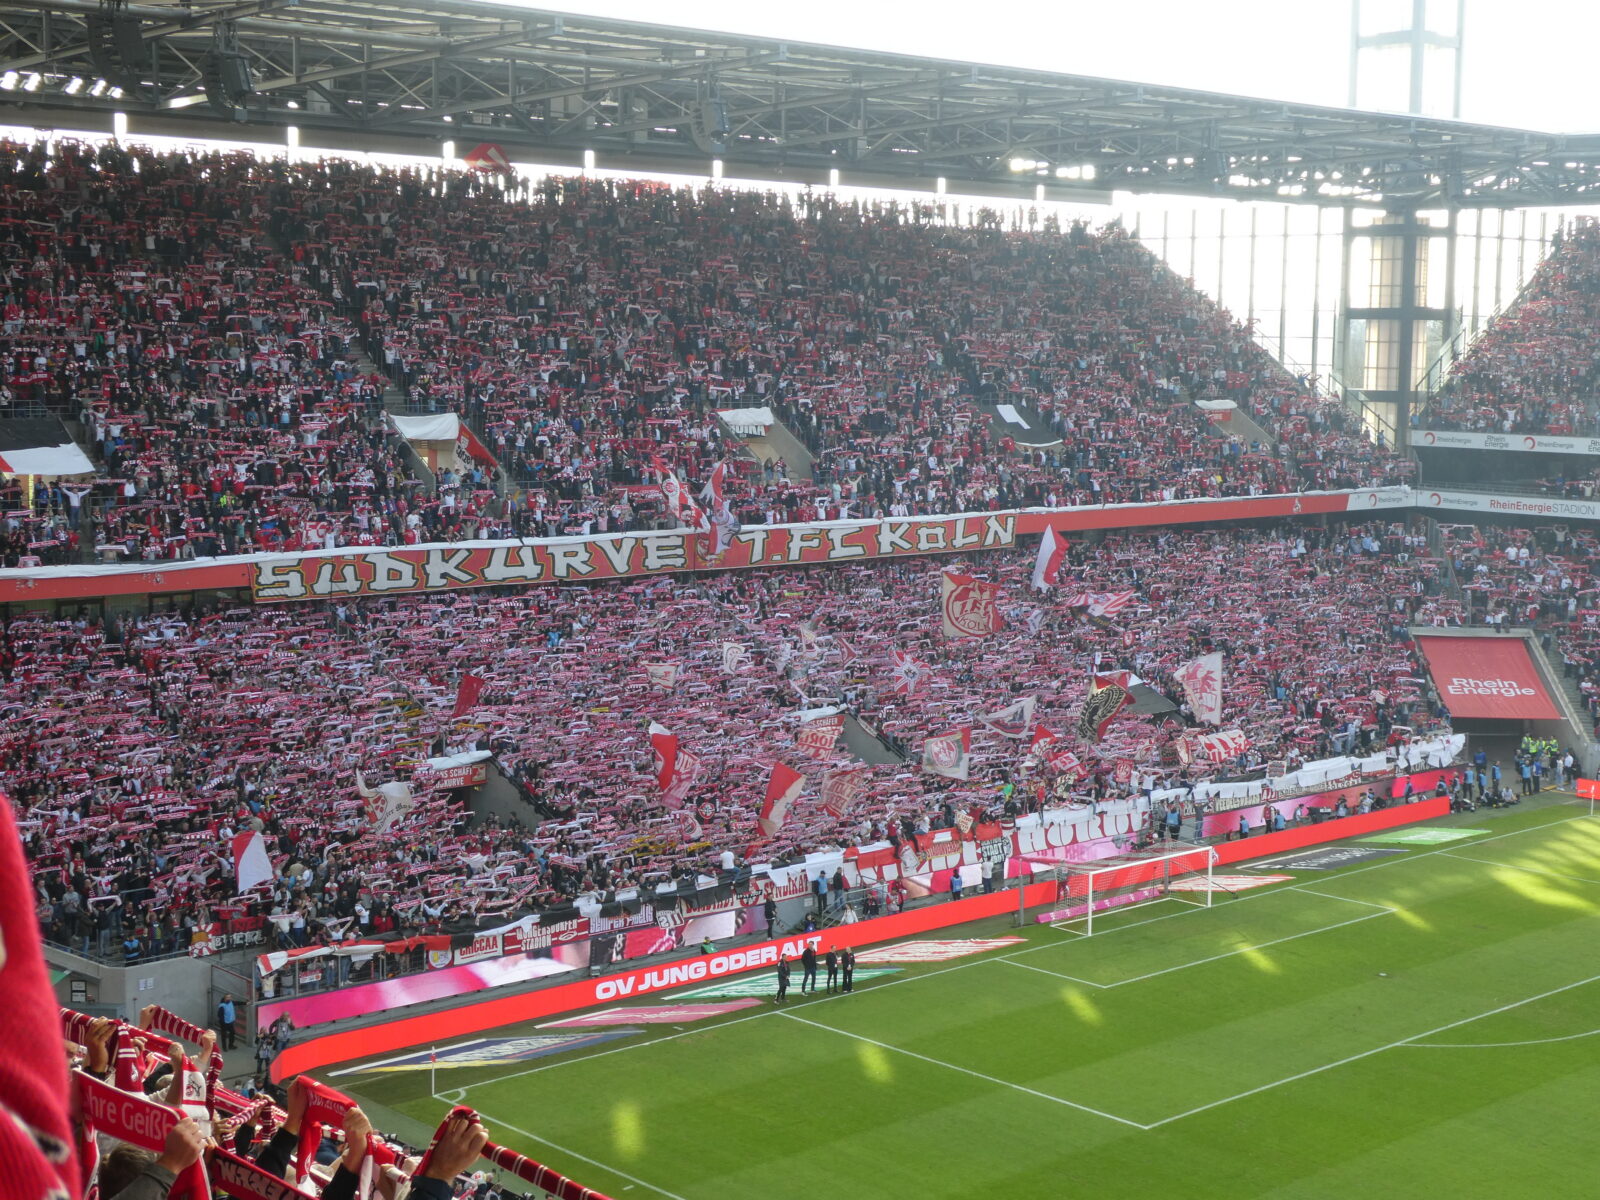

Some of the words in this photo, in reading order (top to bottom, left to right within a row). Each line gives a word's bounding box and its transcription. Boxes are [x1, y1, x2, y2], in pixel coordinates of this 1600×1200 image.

[1484, 441, 1509, 449] Energie
[1486, 435, 1506, 443] Rhein
[1490, 499, 1595, 516] RheinEnergieSTADION
[1452, 677, 1518, 688] Rhein
[1447, 685, 1536, 697] Energie
[521, 935, 552, 951] STADION
[595, 975, 636, 1000] OV
[637, 959, 708, 992] JUNG
[709, 946, 778, 975] ODER
